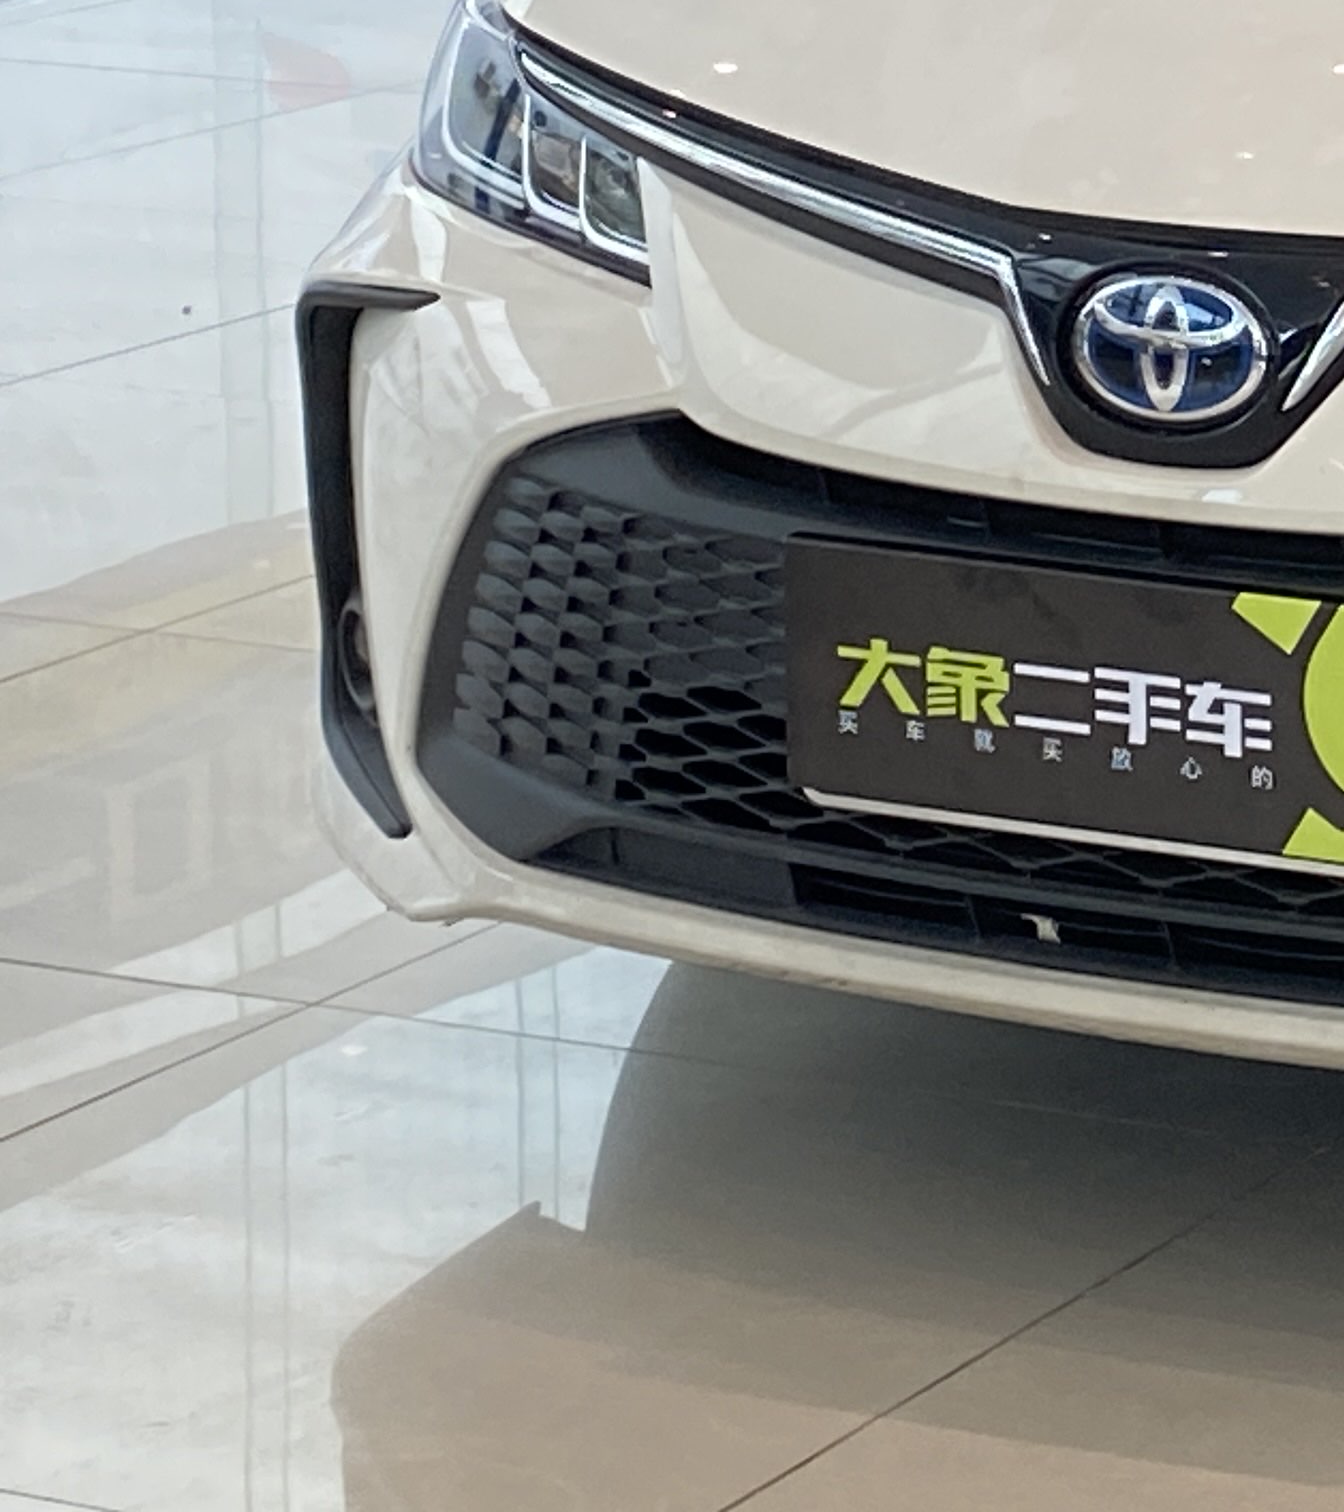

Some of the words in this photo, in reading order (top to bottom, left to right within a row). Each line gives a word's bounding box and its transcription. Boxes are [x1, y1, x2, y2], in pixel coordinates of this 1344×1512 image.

[836, 637, 1273, 759] 大象二手车
